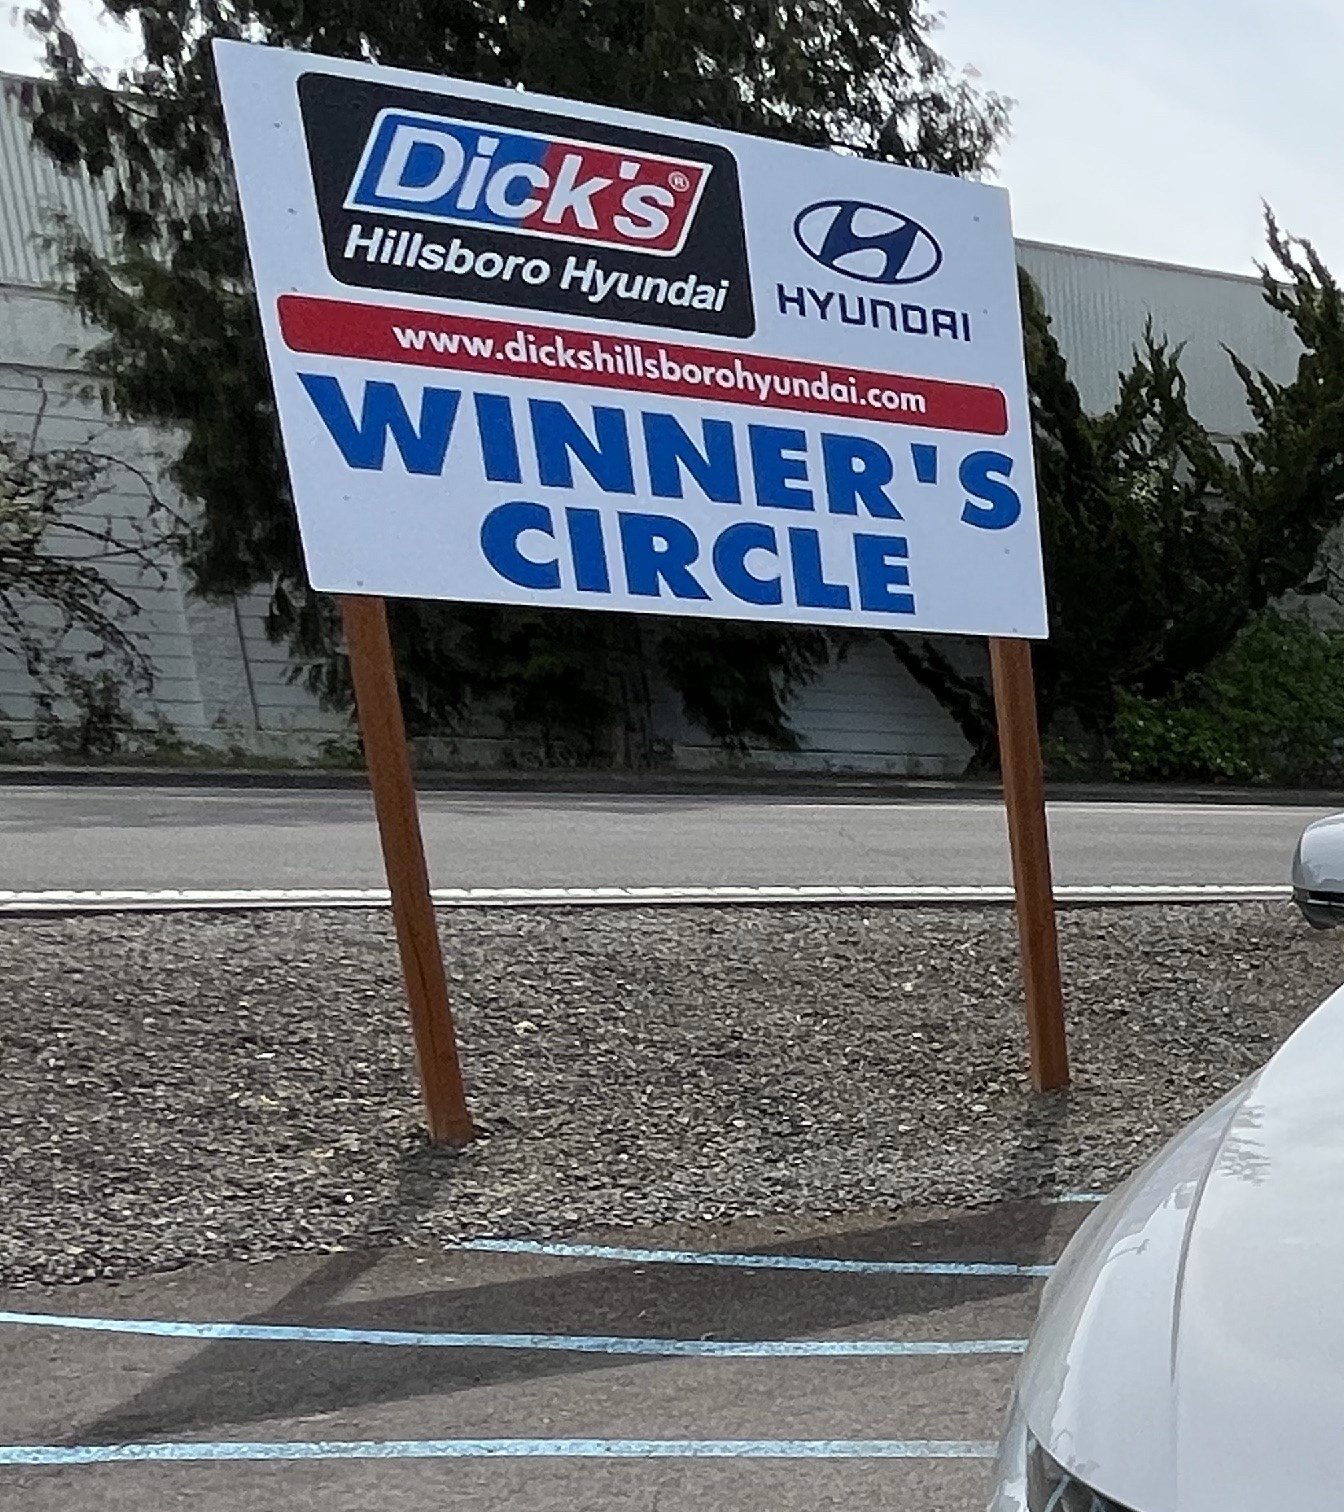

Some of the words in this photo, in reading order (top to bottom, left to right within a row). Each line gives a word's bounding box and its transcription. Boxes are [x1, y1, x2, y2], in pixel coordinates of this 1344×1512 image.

[343, 224, 550, 286] Hillsboro
[561, 255, 730, 314] Hyundai
[777, 284, 972, 343] HYUNDAI
[392, 323, 926, 414] www.dickshillsborohyundai.com
[297, 373, 1023, 530] WINNER'S
[479, 501, 917, 616] CIRCLE
